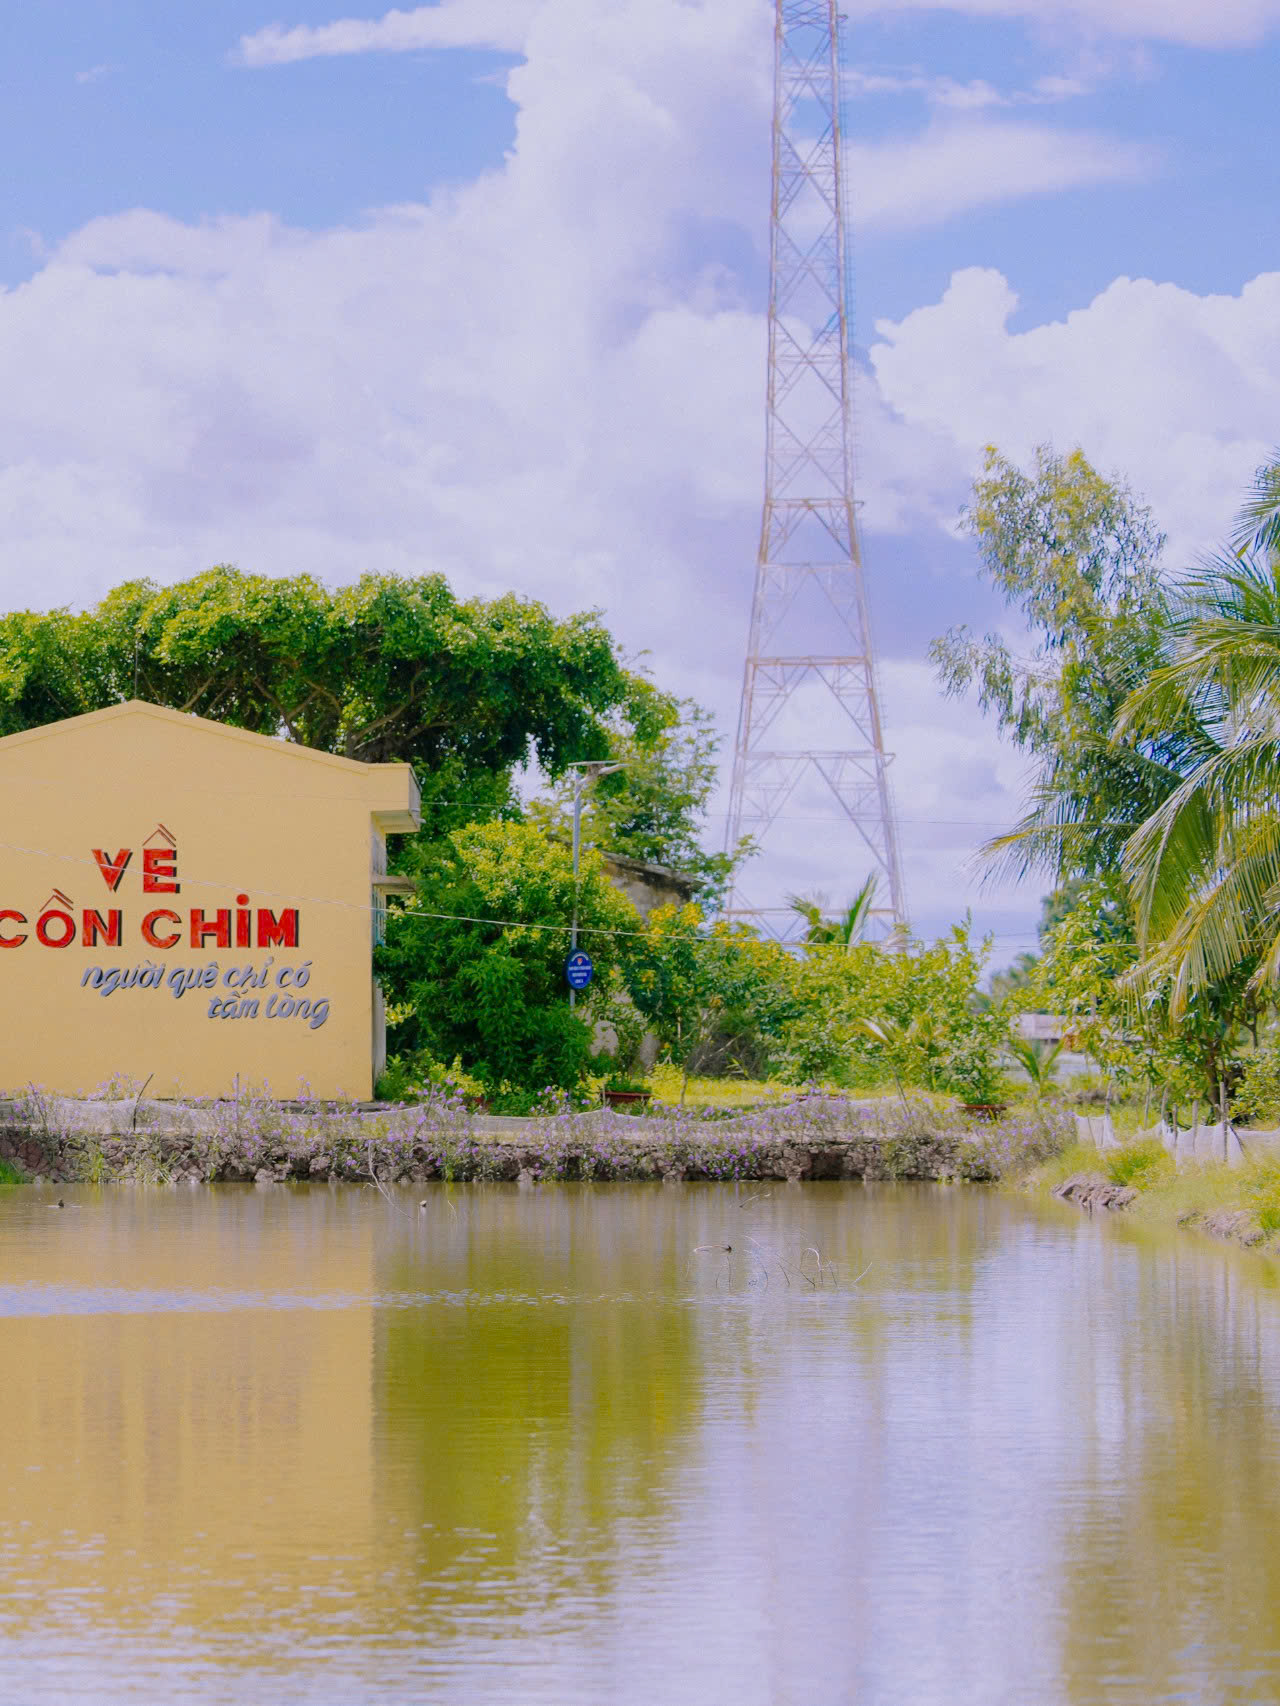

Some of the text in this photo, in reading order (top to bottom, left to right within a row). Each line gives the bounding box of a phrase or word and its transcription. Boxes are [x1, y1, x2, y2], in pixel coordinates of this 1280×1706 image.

[91, 823, 181, 894] VỀ
[79, 956, 313, 998] người quê chỉ có
[207, 989, 330, 1030] tấm lòng
